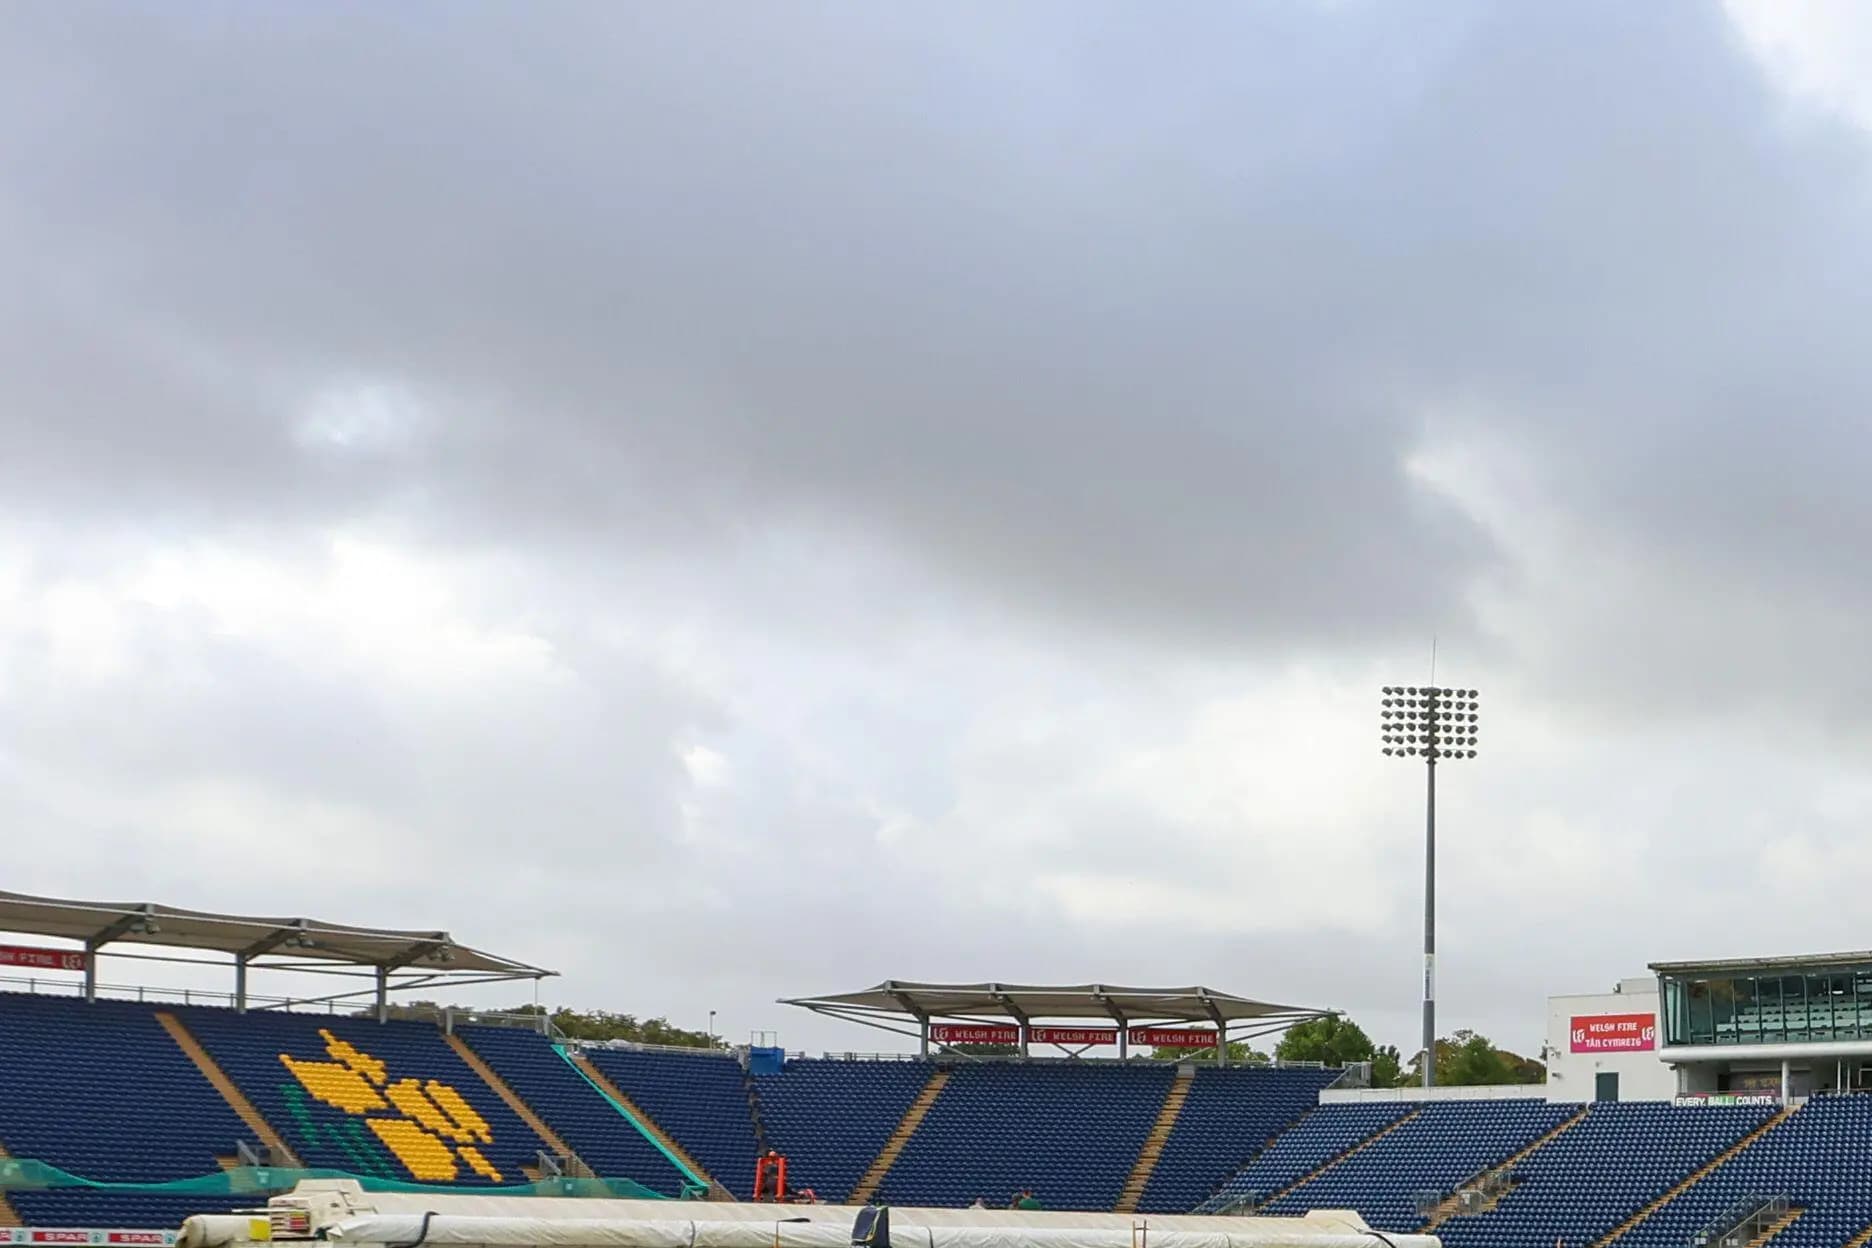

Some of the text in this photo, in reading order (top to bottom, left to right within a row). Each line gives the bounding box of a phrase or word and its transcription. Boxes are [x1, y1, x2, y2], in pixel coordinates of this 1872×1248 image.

[1589, 1022, 1637, 1032] WELSH FIRE
[1736, 1095, 1775, 1106] COUNTS.
[44, 1232, 88, 1241] SPAR
[120, 1233, 162, 1243] SPAR
